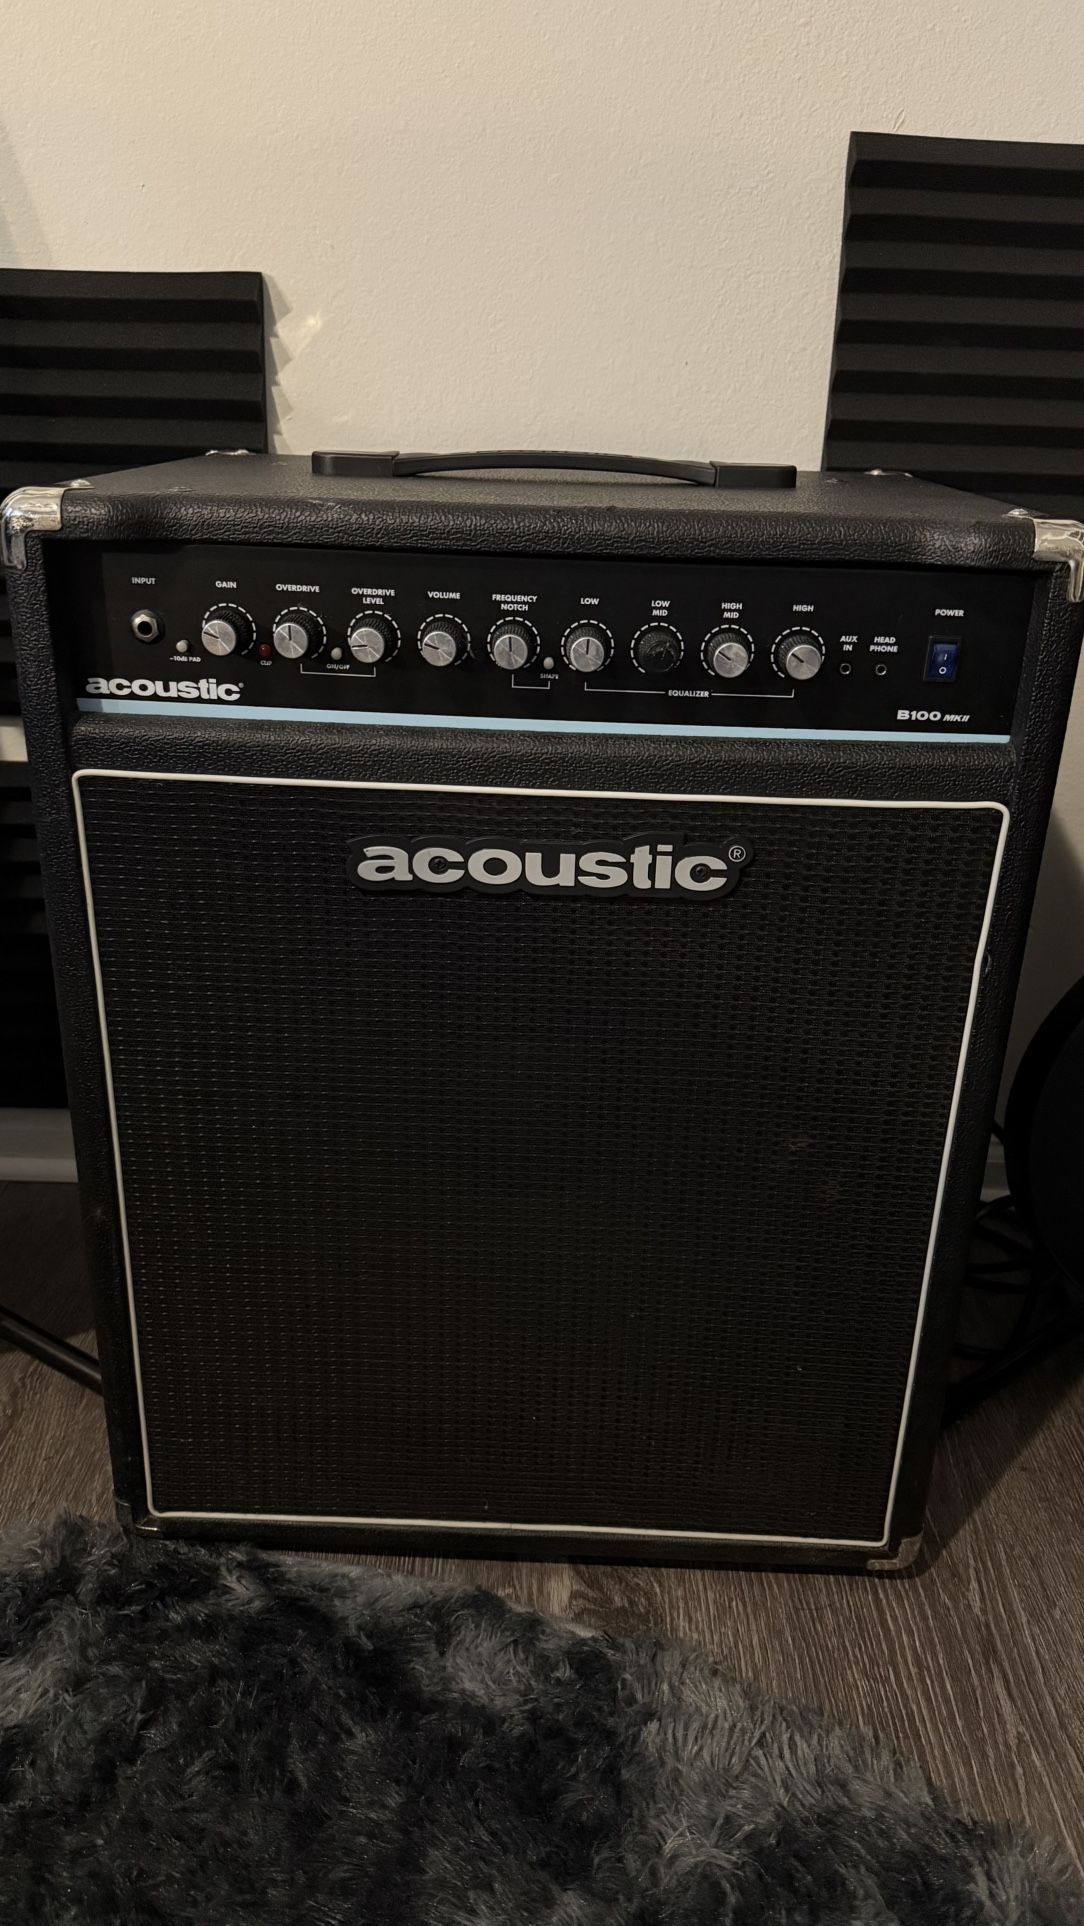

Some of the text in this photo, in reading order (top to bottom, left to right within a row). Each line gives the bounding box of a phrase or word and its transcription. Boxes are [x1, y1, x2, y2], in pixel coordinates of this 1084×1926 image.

[131, 577, 156, 585] INPUT
[215, 580, 237, 589] GAIN
[275, 584, 320, 593] OVERDRIVE
[351, 587, 396, 597] OVERDRIVE
[427, 591, 461, 600] VOLUME
[492, 594, 538, 603] FREQUENCY
[362, 597, 384, 605] LEVEL
[580, 597, 600, 606] LOW
[651, 600, 671, 608] LOW
[500, 603, 529, 612] NOTCH
[721, 602, 743, 611] HIGH
[792, 604, 815, 613] HIGH
[652, 609, 668, 617] MID
[723, 611, 740, 619] MID
[934, 609, 965, 617] POWER
[840, 635, 858, 643] AUX
[873, 636, 896, 644] HEAD
[843, 644, 853, 652] IN
[869, 645, 899, 653] PHONE
[668, 689, 709, 698] EQUALIZER
[896, 709, 970, 723] B100 MKII
